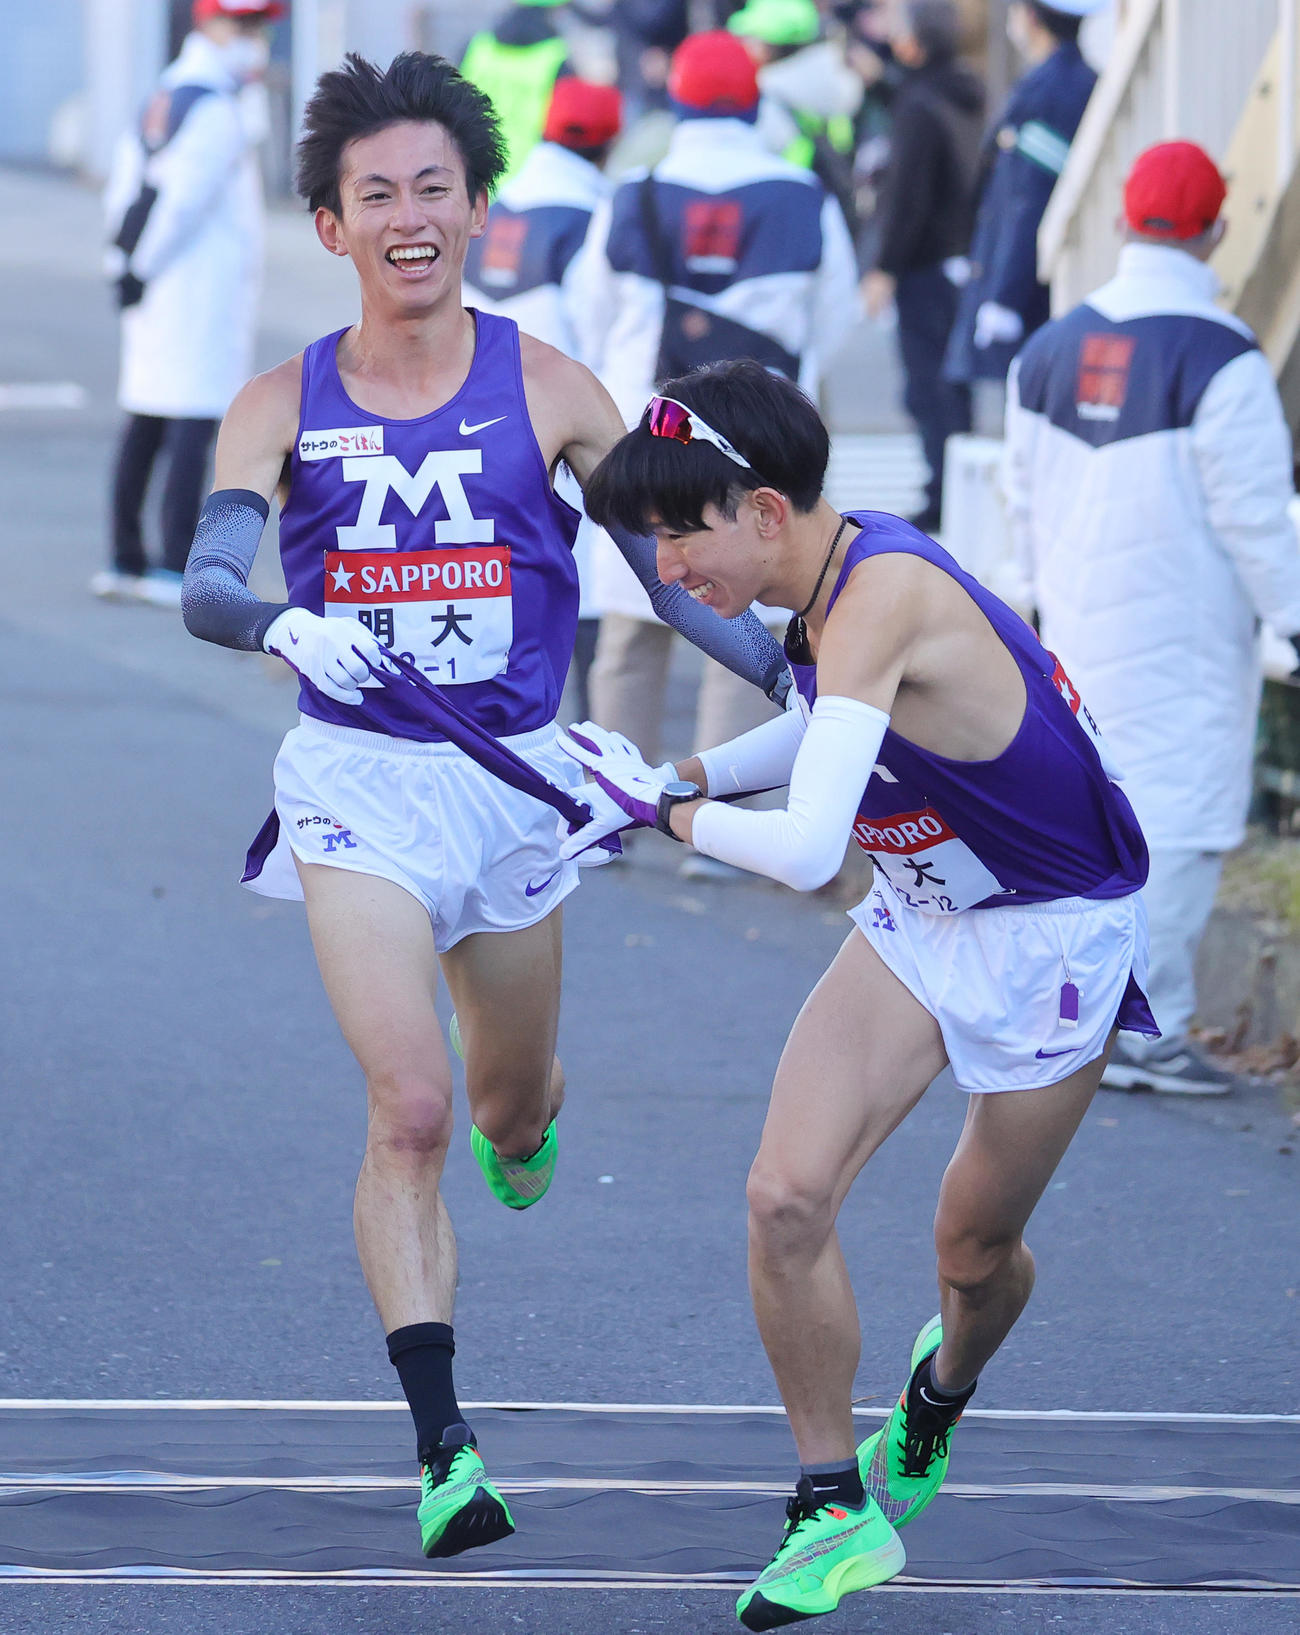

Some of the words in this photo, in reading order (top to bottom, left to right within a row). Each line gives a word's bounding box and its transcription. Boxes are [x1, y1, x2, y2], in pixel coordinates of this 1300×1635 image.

[301, 431, 382, 452] サトウのごはん
[336, 449, 494, 550] M
[361, 559, 503, 594] SAPPORO
[322, 830, 357, 852] M
